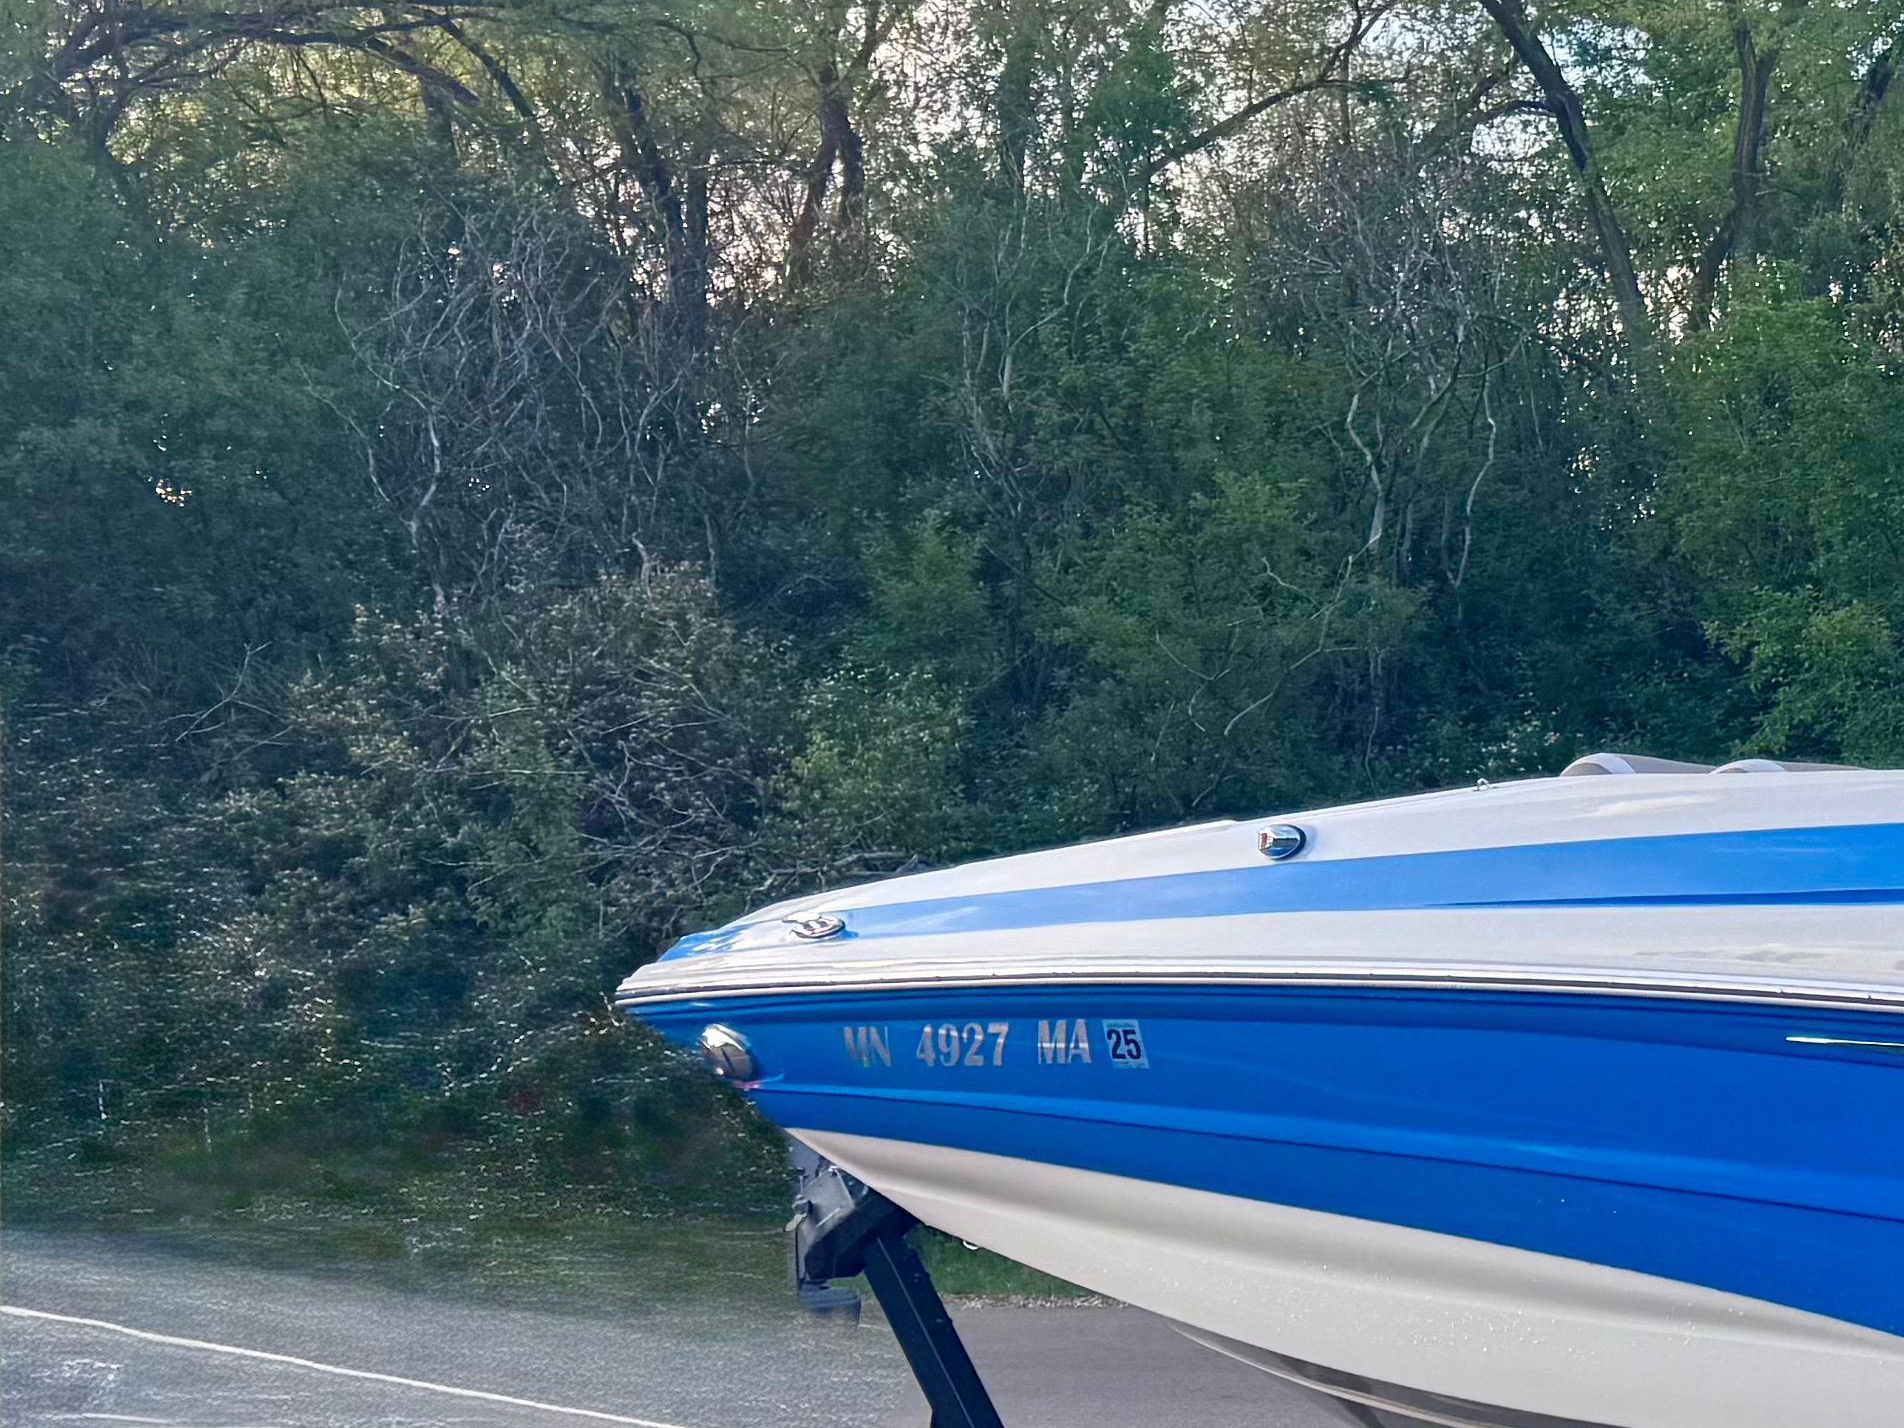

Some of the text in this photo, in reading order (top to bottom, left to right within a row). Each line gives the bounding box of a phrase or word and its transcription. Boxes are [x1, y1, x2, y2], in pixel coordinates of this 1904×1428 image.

[916, 1022, 1009, 1067] 4927
[1038, 1018, 1092, 1064] MA
[1107, 1029, 1141, 1059] 25
